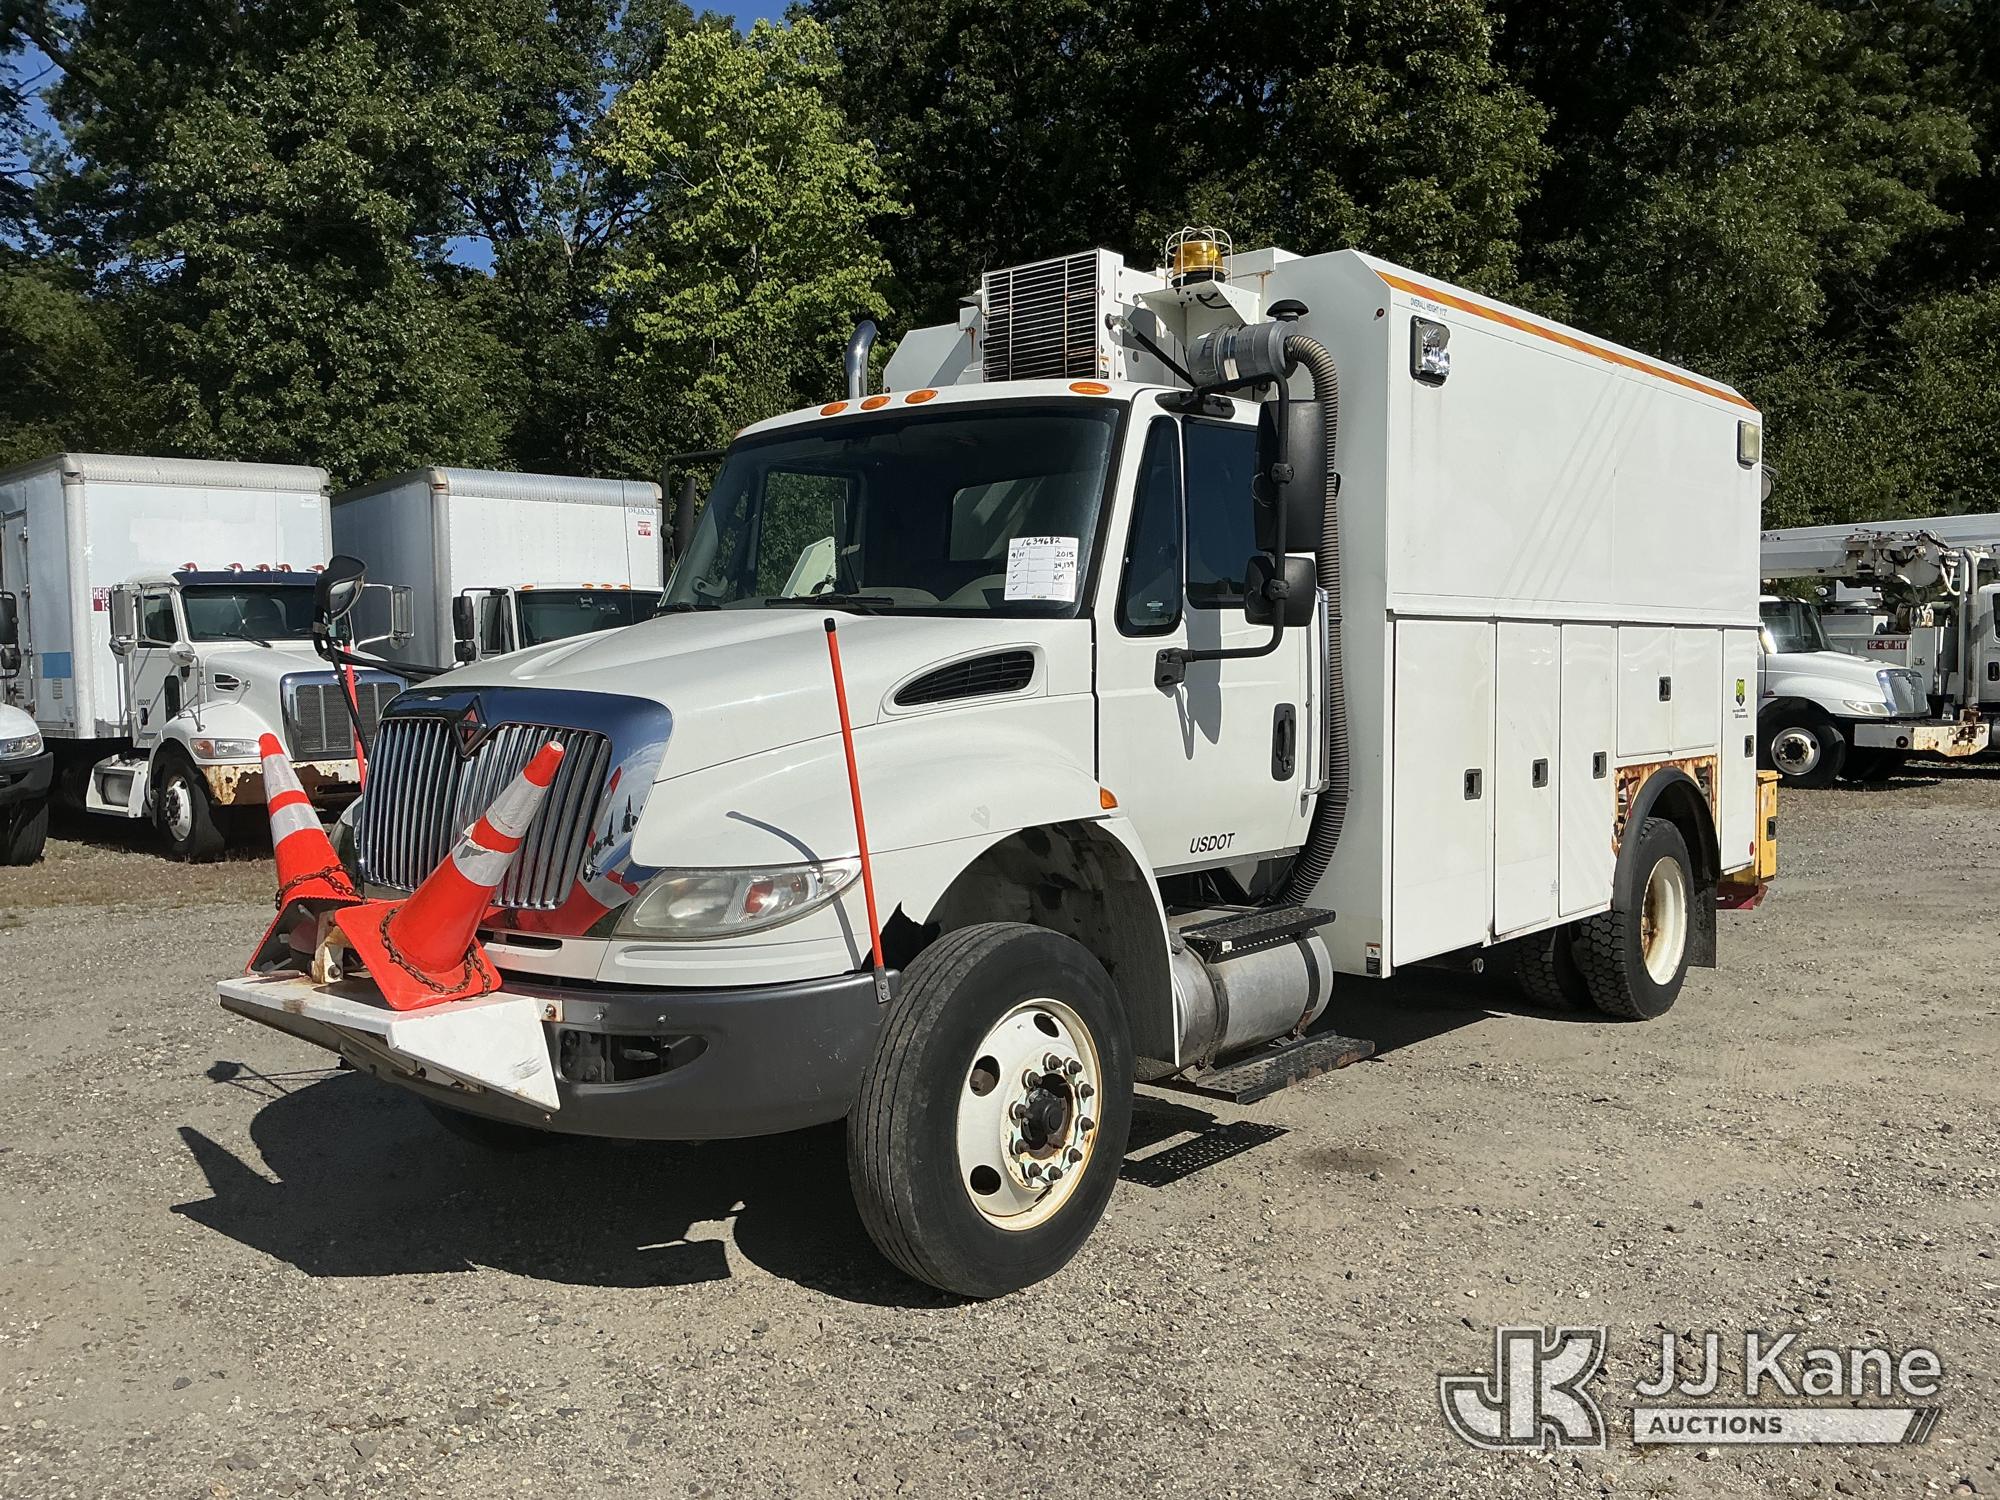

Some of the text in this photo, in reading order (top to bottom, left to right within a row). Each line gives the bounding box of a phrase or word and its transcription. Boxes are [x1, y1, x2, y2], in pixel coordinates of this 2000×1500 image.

[1021, 537, 1061, 546] 1634682
[93, 587, 112, 600] HEIG
[1894, 640, 1906, 649] HT
[1189, 832, 1236, 854] USDOT
